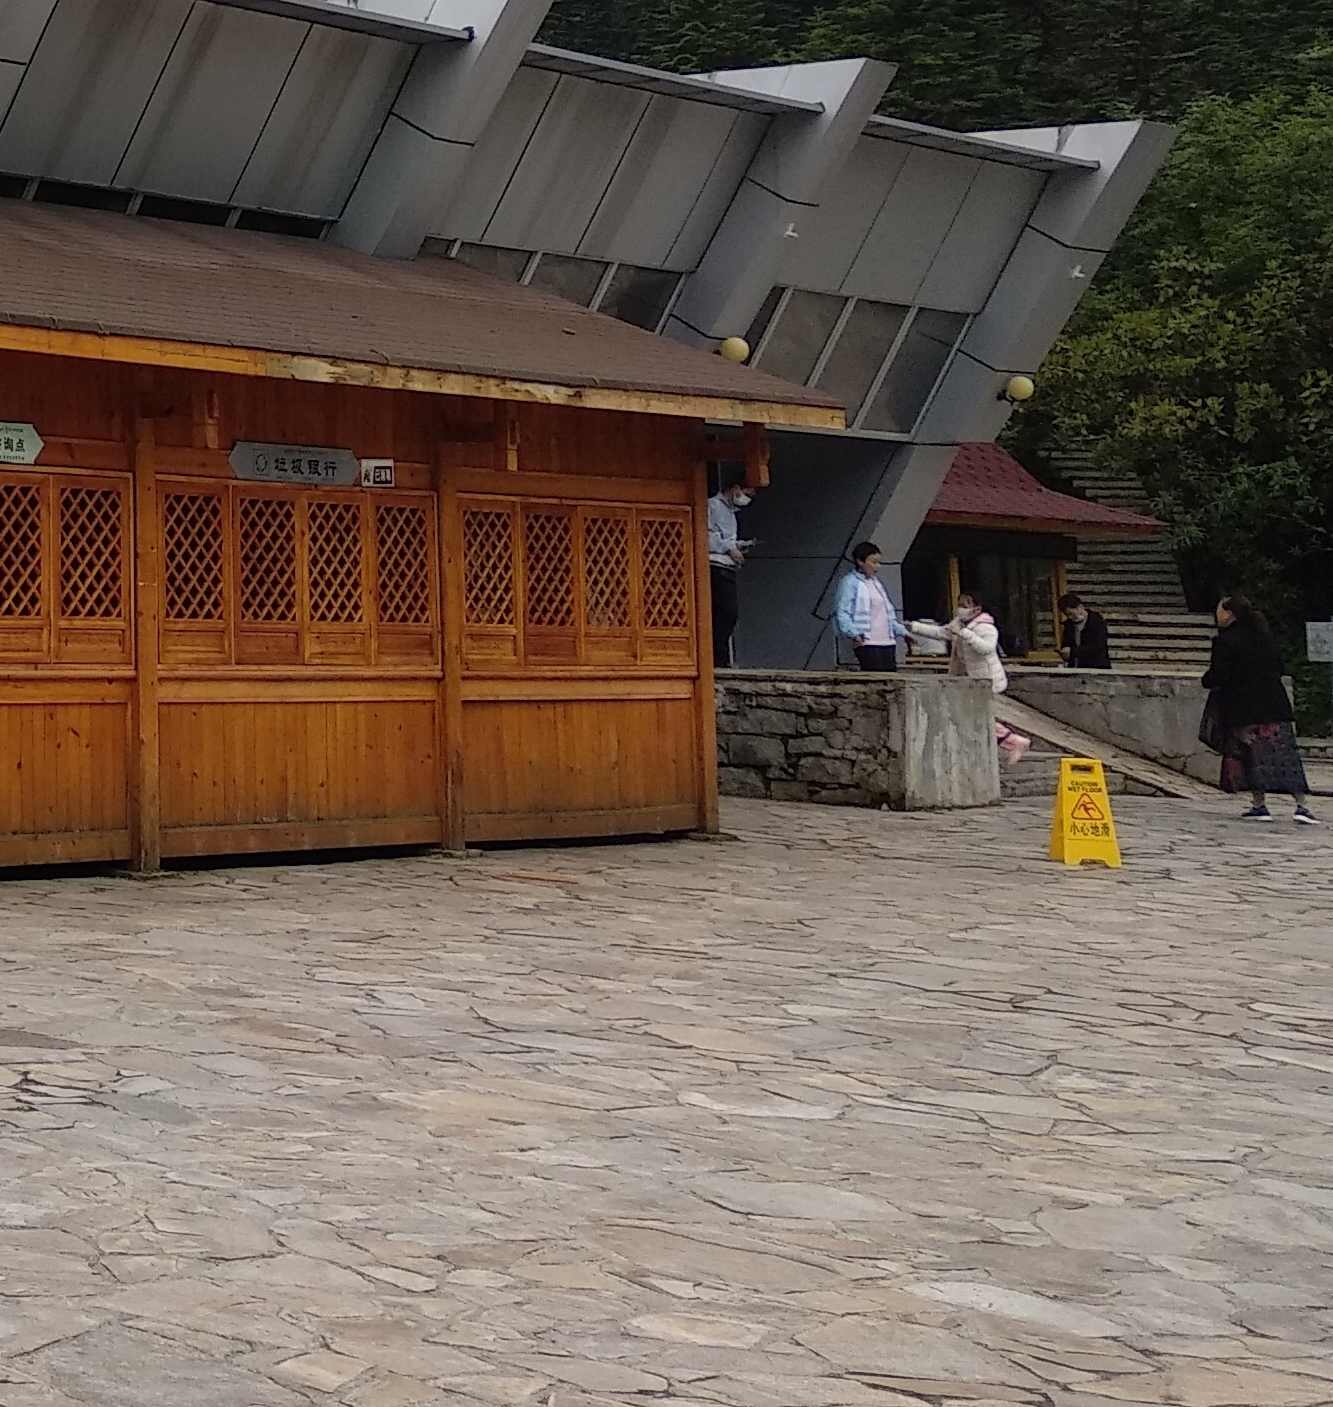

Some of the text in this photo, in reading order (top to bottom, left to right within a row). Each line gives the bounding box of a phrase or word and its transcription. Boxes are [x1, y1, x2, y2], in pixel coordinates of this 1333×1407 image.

[274, 457, 338, 477] 垃圾银行
[1070, 821, 1110, 837] 小心地滑
